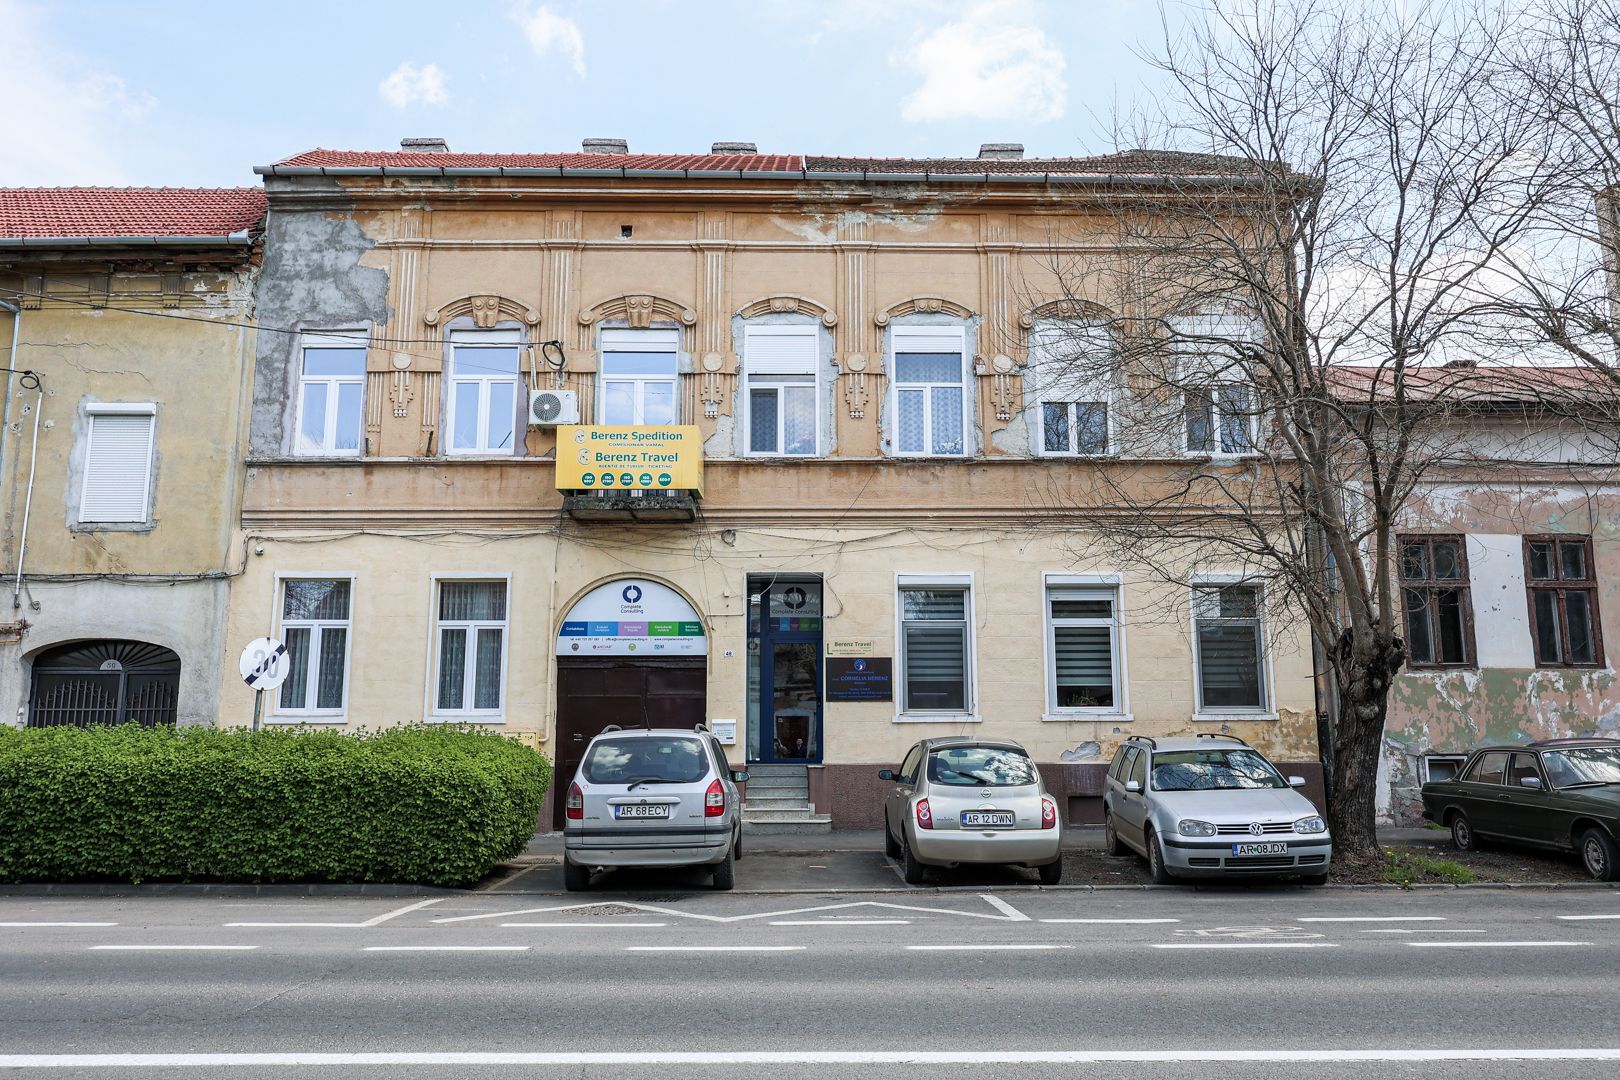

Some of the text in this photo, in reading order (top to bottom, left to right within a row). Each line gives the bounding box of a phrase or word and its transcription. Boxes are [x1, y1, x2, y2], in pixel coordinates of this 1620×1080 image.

[591, 431, 683, 442] Berenz Spedition
[595, 452, 678, 462] Berenz Travel
[252, 648, 280, 678] 30
[621, 806, 633, 815] AR
[968, 814, 979, 823] AR
[1239, 845, 1254, 855] AR
